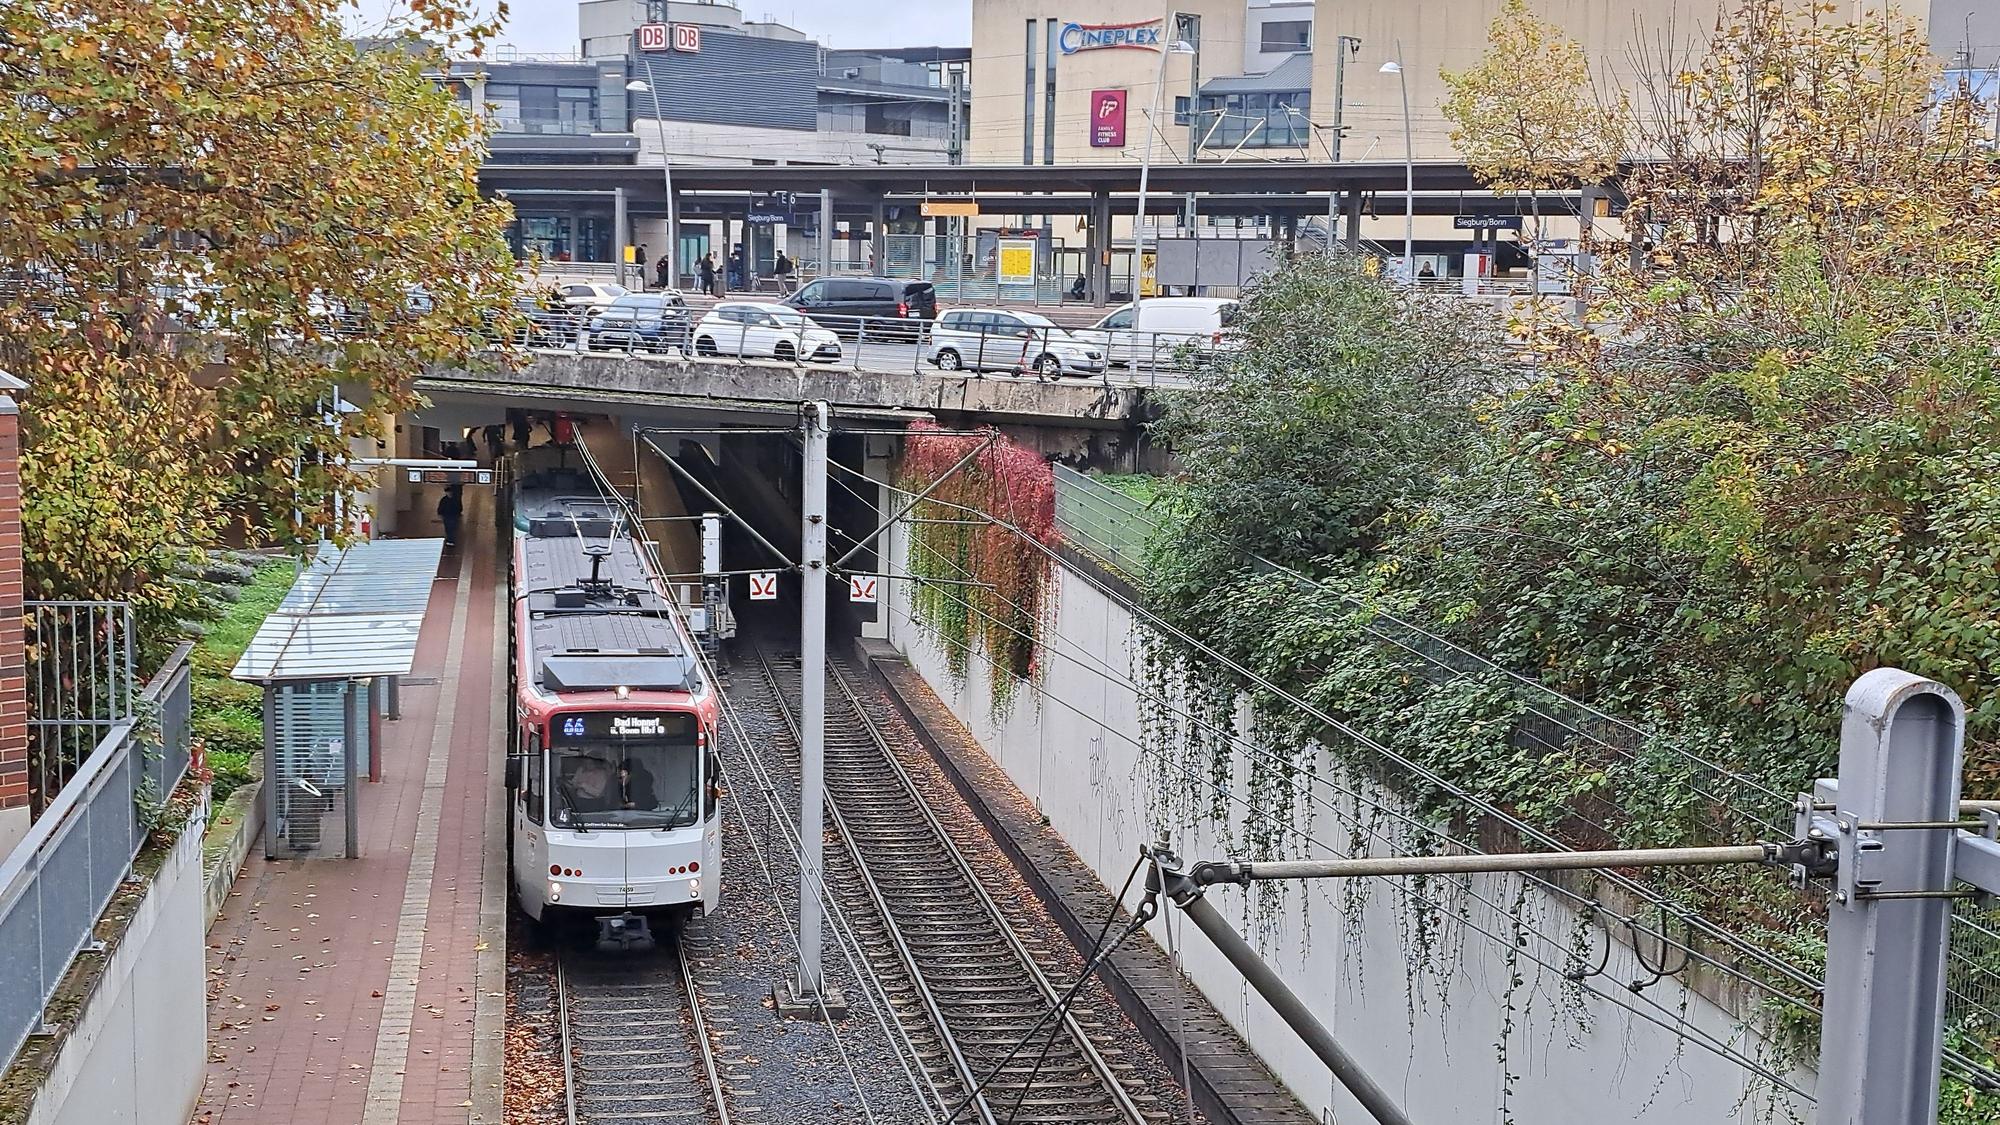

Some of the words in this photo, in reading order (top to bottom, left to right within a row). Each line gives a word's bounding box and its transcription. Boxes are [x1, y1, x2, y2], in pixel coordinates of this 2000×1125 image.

[643, 28, 663, 46] DB
[679, 28, 697, 47] DB
[1059, 22, 1159, 54] CINEPLEX
[790, 192, 796, 204] 6
[748, 214, 784, 223] Siegburg/Bonn
[1457, 218, 1507, 227] Siegburg/Bonn
[563, 717, 585, 735] 66
[614, 717, 630, 727] Bad
[631, 717, 660, 727] Honnef
[560, 809, 567, 822] 4
